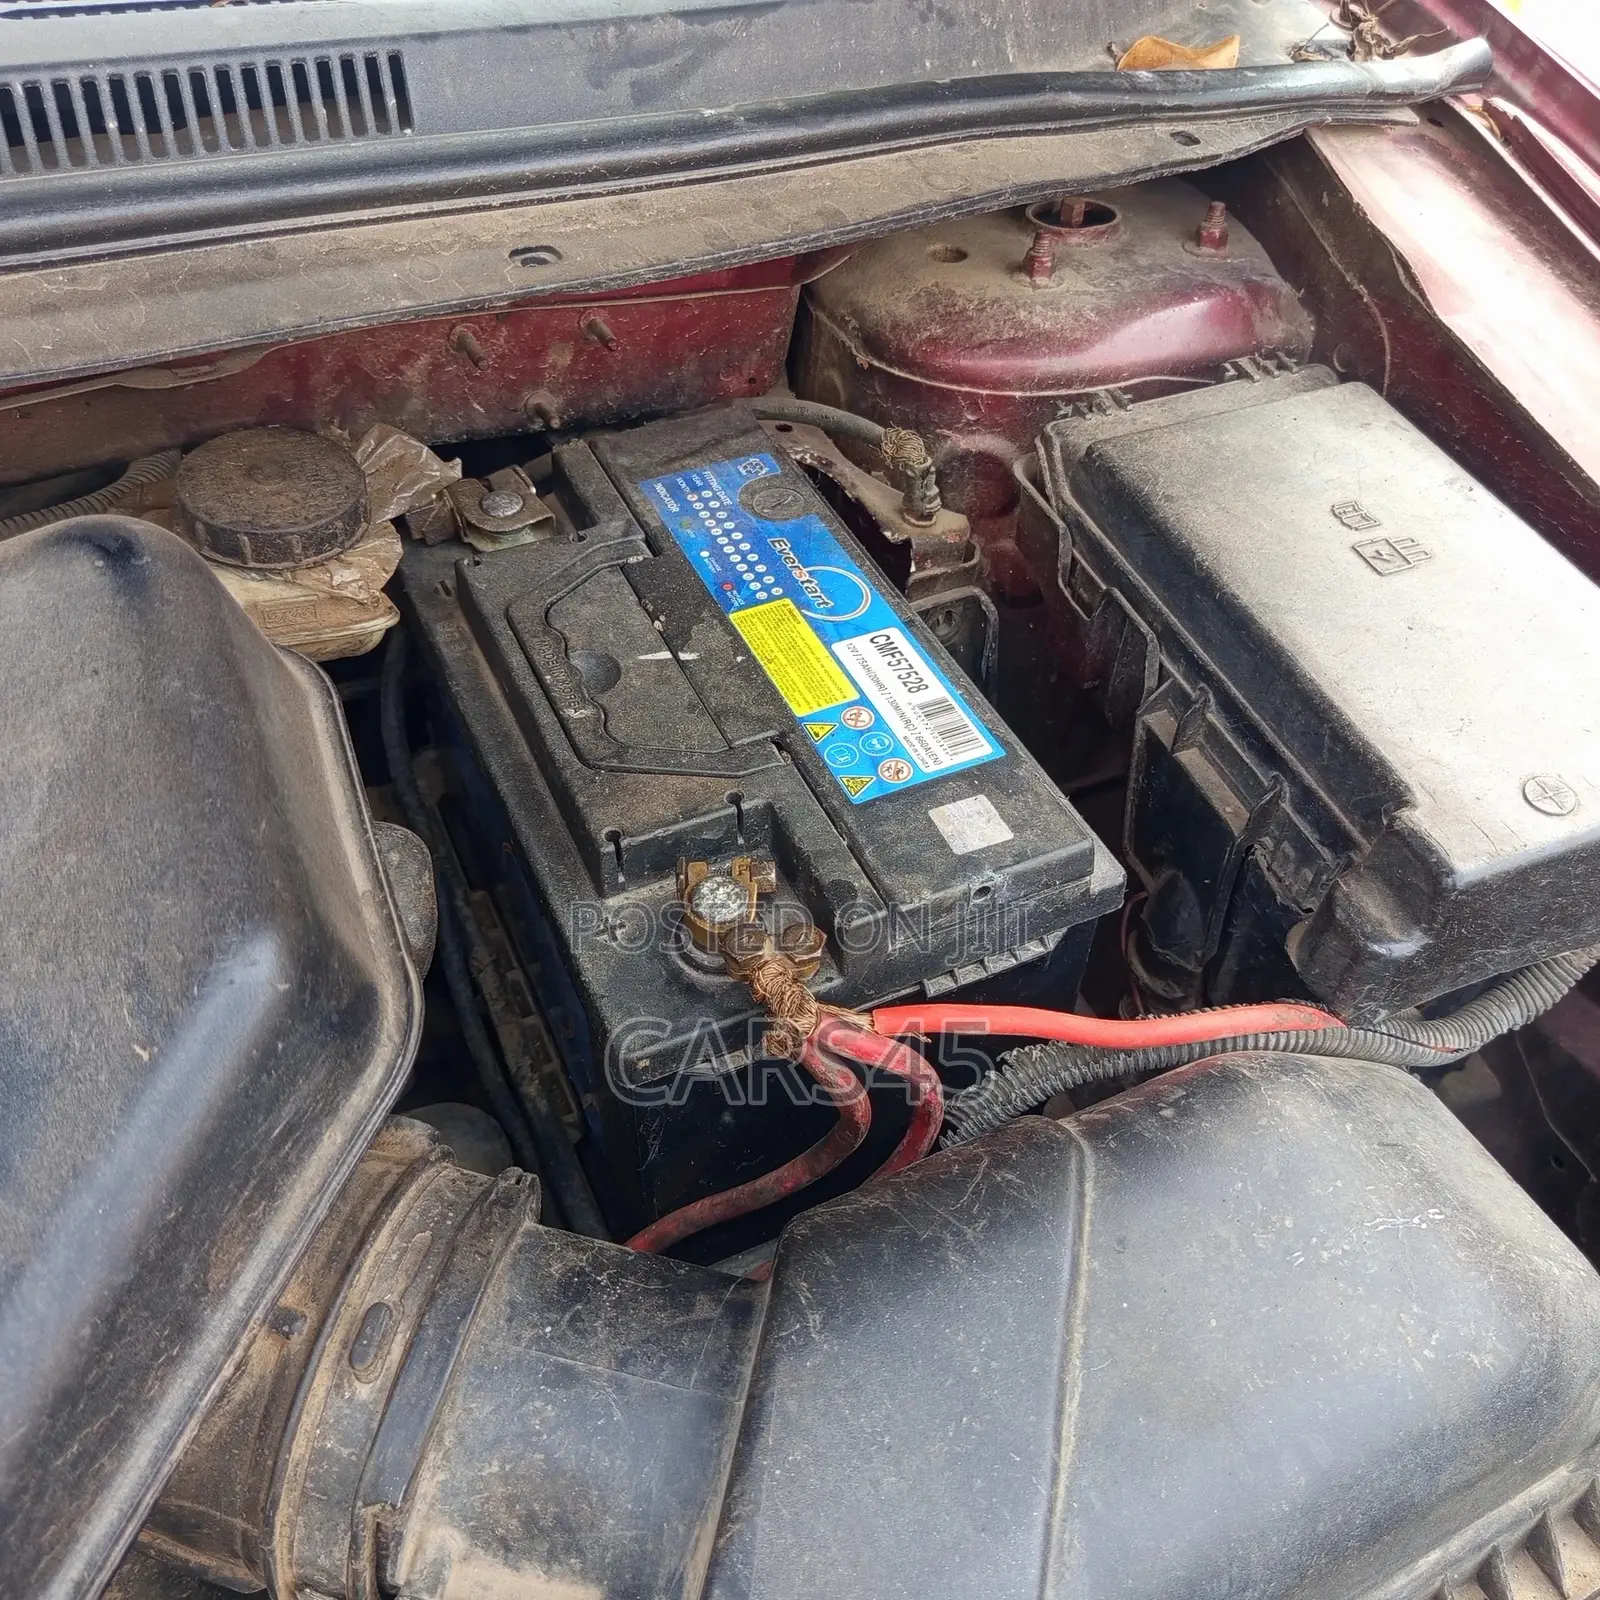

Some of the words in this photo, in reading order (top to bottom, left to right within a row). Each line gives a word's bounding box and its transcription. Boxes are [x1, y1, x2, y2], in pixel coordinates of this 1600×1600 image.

[676, 477, 692, 493] MONTH
[691, 474, 704, 487] YEAR
[701, 470, 722, 491] FITTING
[715, 490, 733, 506] DATE
[653, 482, 680, 513] INDICATOR
[767, 537, 834, 608] Everstart
[869, 634, 929, 694] CMF57528
[902, 735, 915, 748] MADE
